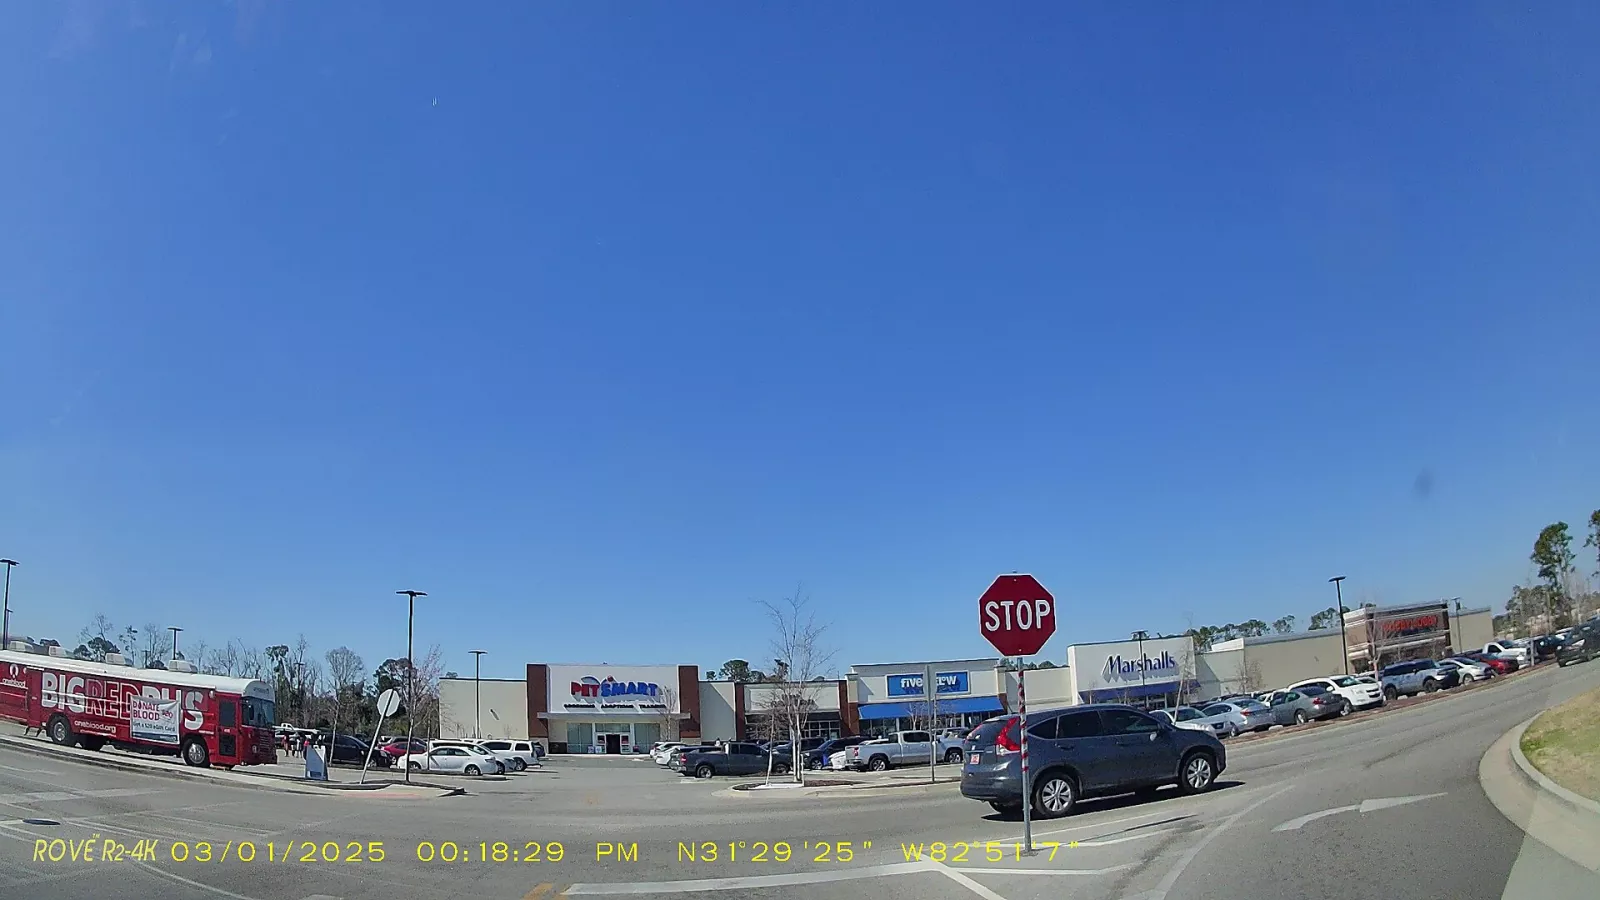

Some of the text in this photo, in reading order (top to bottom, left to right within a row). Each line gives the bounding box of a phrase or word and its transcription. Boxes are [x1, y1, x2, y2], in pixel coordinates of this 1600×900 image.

[984, 599, 1051, 632] STOP
[1107, 651, 1176, 675] Marshalls
[133, 700, 160, 712] DONATE
[133, 709, 160, 721] BLOOD
[74, 720, 117, 734] oneblood.org
